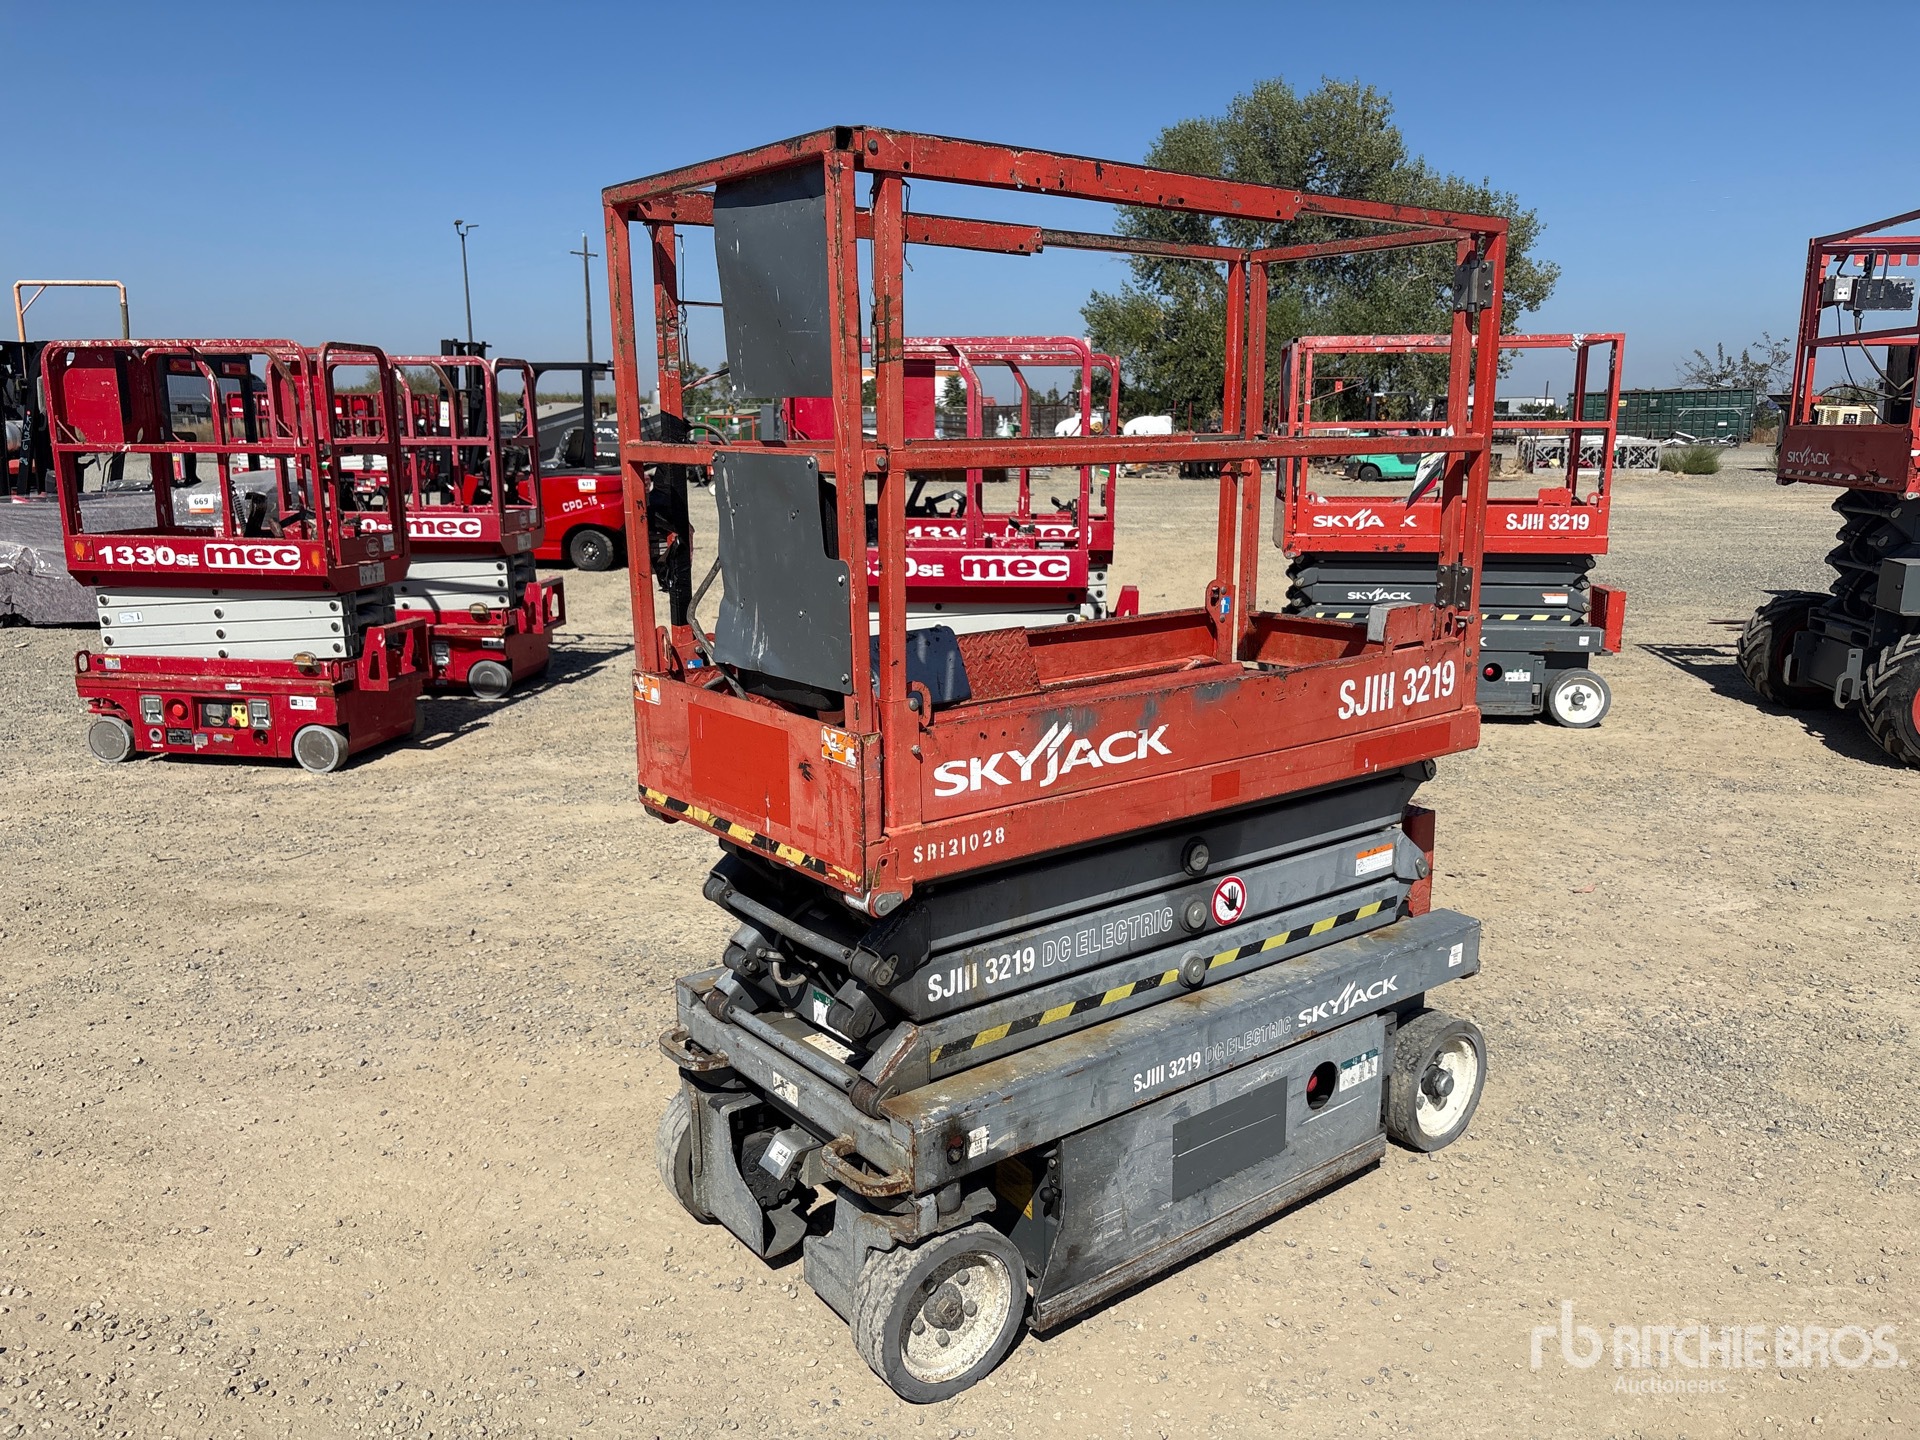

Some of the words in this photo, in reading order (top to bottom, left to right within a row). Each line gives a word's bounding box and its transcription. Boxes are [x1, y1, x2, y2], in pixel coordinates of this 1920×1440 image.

[1787, 445, 1830, 466] SKYJACK
[193, 497, 209, 506] 669
[1313, 508, 1418, 530] SKYJAK
[1549, 513, 1590, 530] 3219
[208, 545, 299, 567] mec
[963, 558, 1068, 578] mec
[1347, 587, 1412, 601] SKYJACK
[1402, 660, 1456, 706] 3219
[933, 720, 1173, 797] SKYJACK
[927, 962, 978, 1002] SJIII
[985, 946, 1036, 984] 3219
[1042, 935, 1072, 968] DC
[1075, 906, 1174, 958] ELECTRIC
[1133, 1064, 1165, 1093] SJIII
[1168, 1051, 1201, 1079] 3219
[1204, 1041, 1225, 1065] DC
[1226, 1015, 1292, 1057] ELECTRIC
[1297, 974, 1399, 1028] SKYJACK
